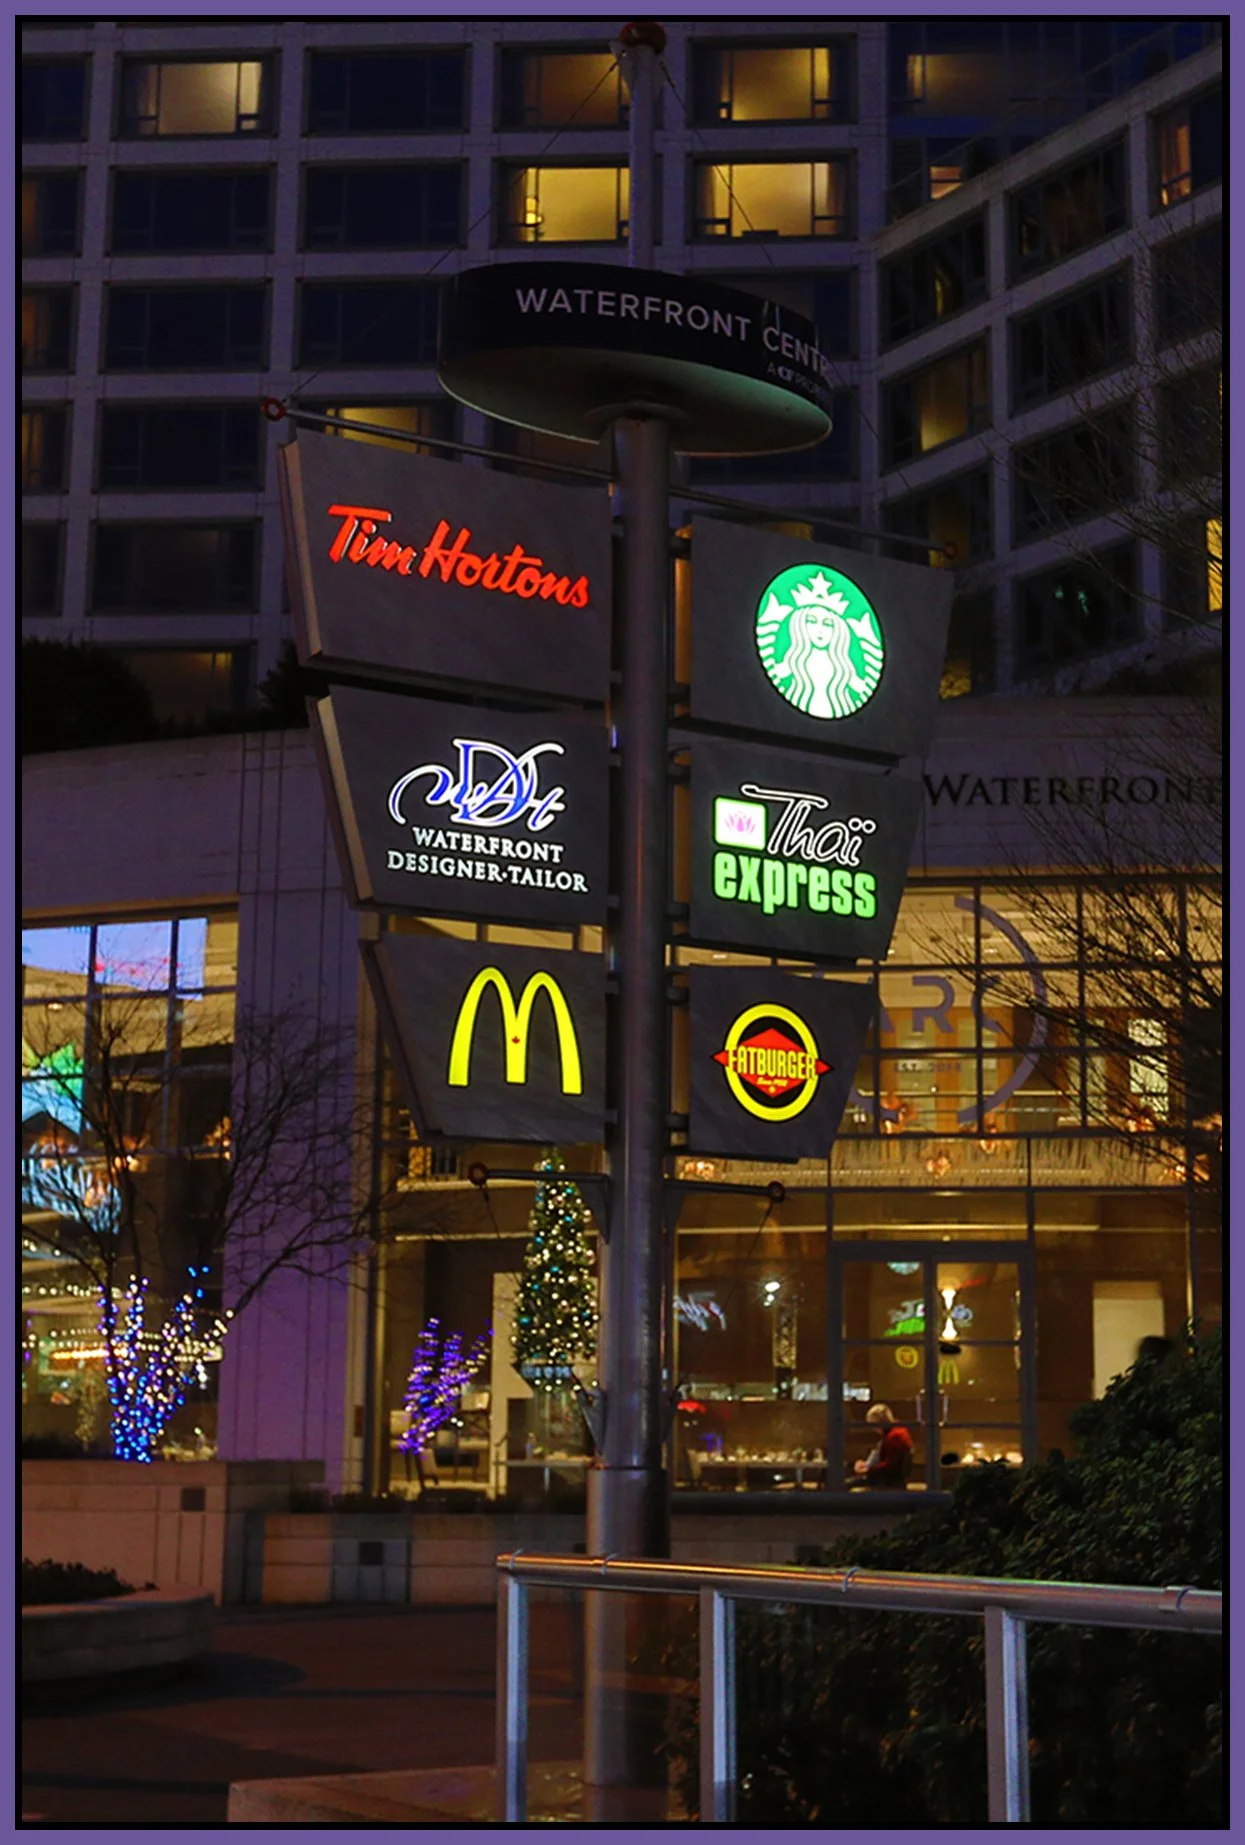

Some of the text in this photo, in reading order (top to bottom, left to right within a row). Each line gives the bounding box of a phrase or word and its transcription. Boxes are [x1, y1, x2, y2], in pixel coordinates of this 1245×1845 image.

[515, 287, 752, 341] WATERFRONT
[327, 504, 590, 608] Tim Hortons
[412, 826, 564, 864] WATERFRONT
[741, 784, 877, 866] Thaï
[714, 852, 876, 919] express
[728, 1045, 817, 1081] FATBURGER
